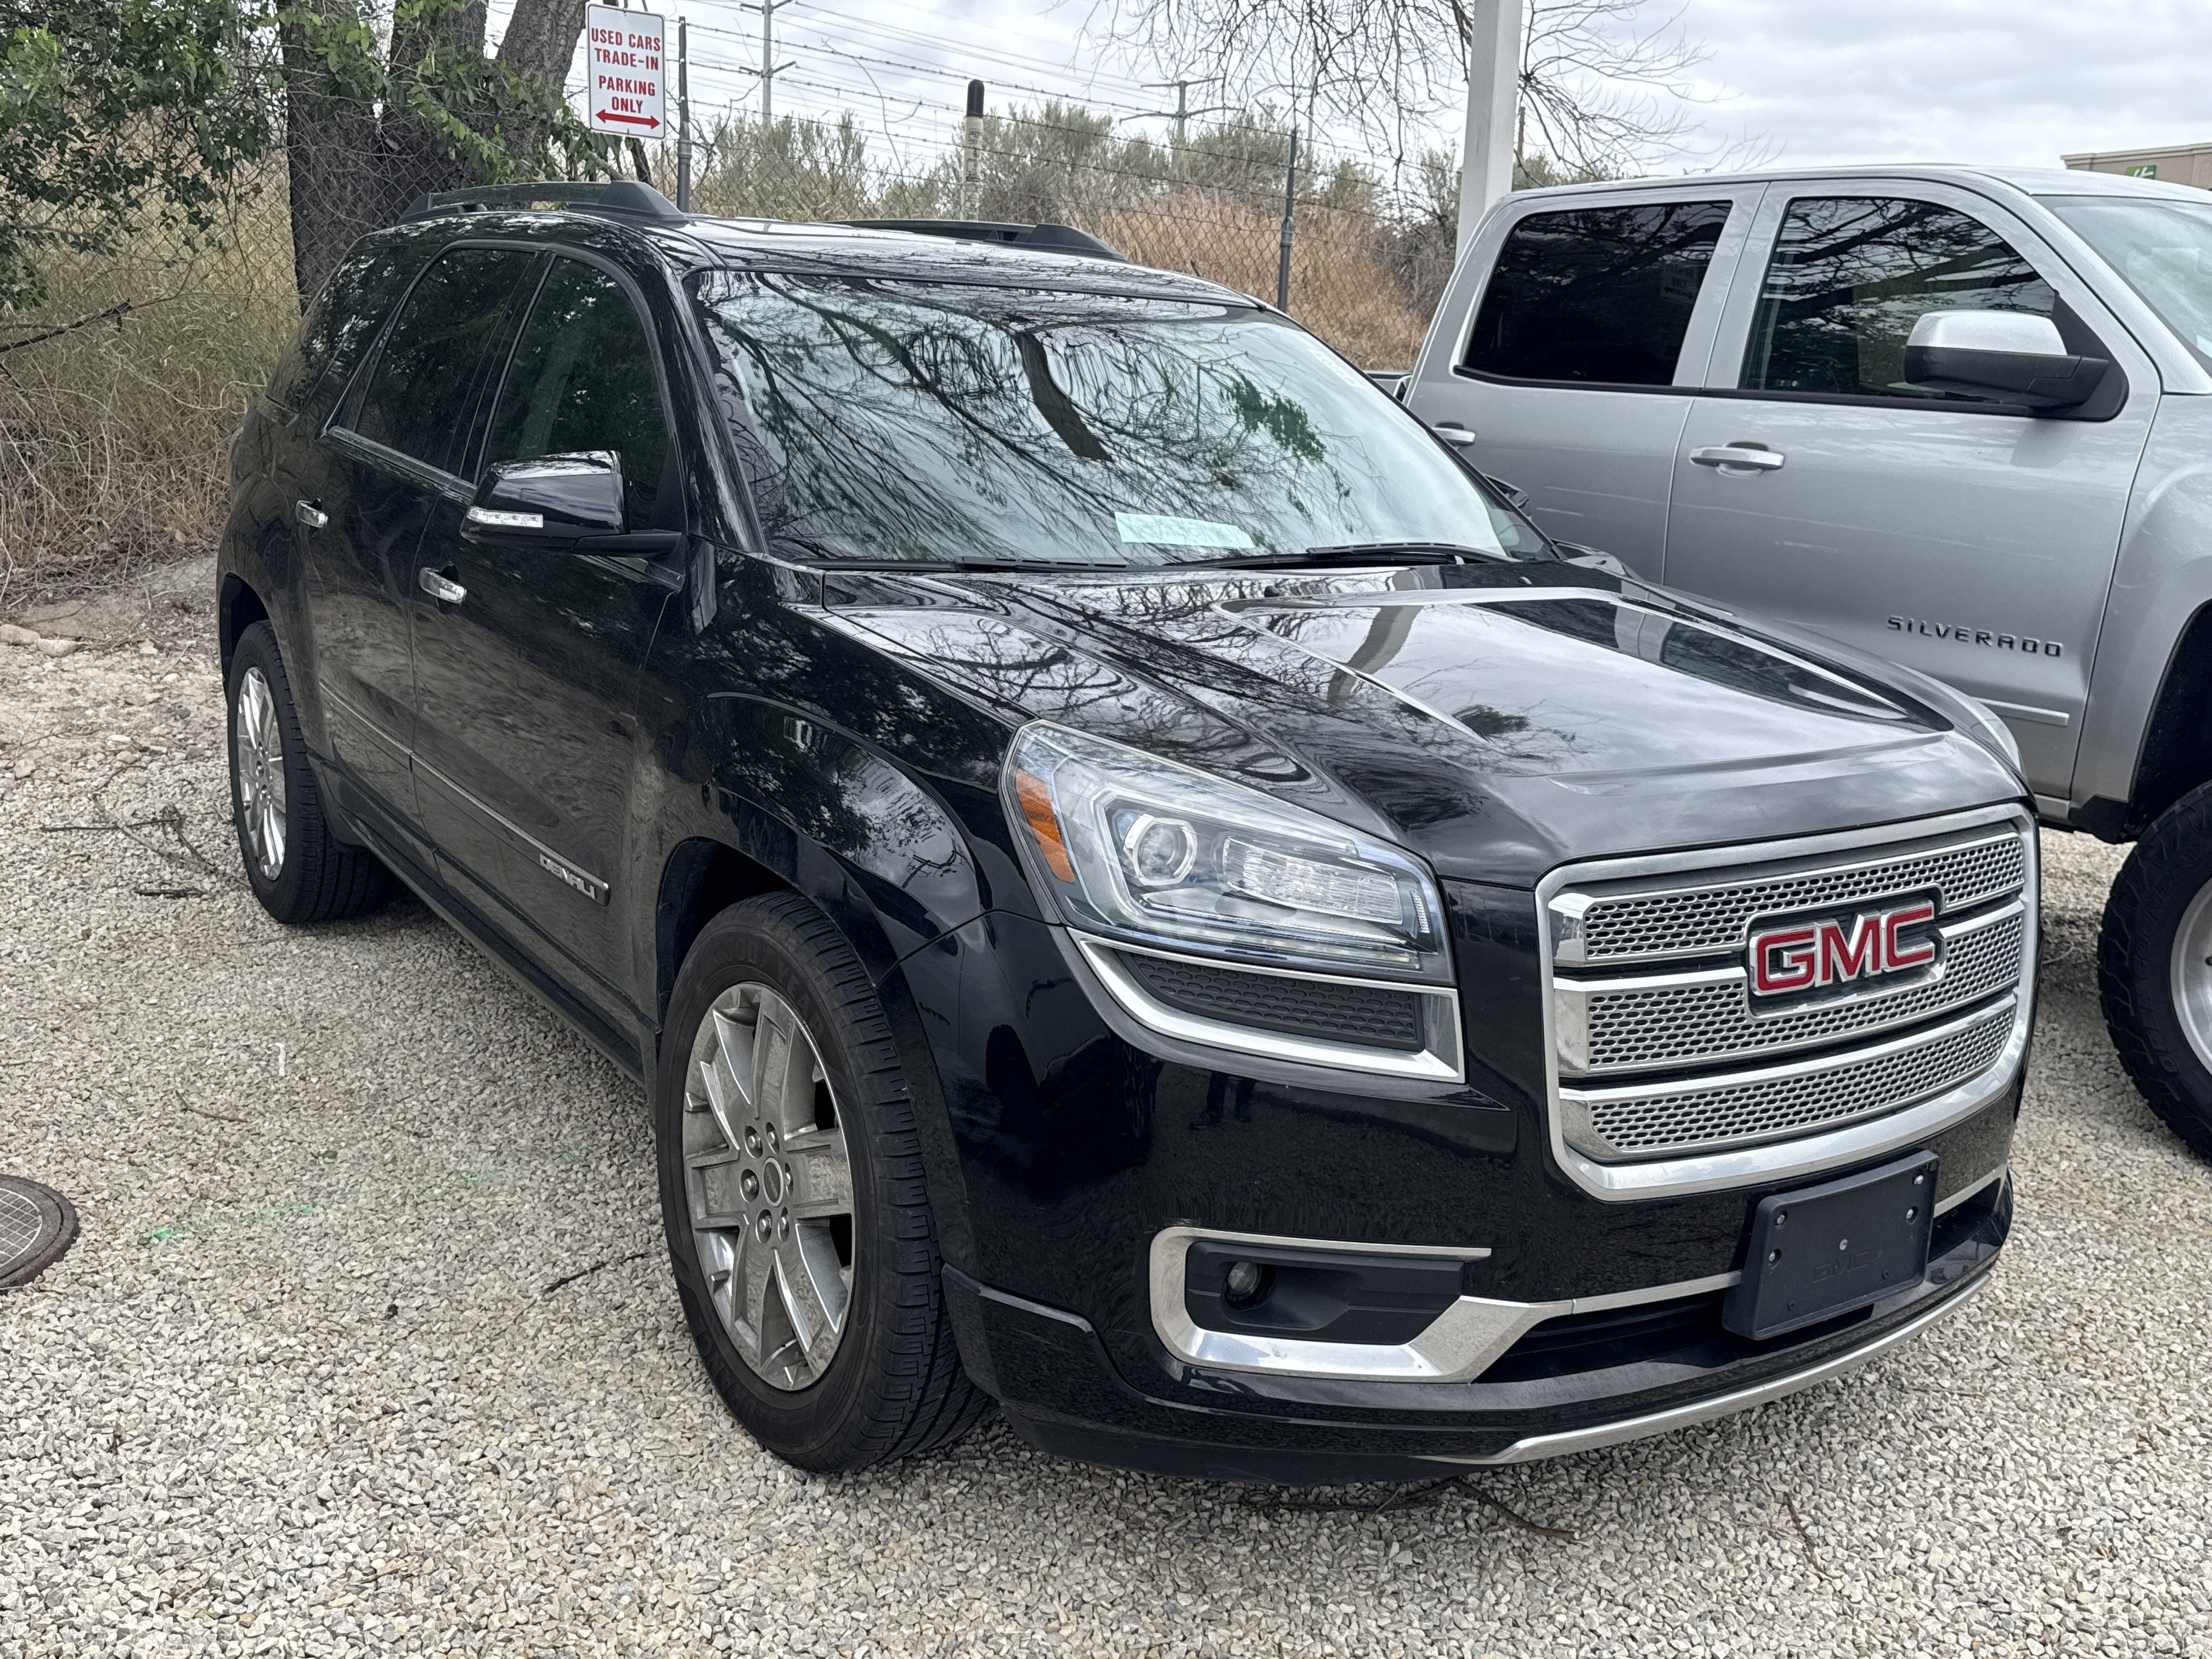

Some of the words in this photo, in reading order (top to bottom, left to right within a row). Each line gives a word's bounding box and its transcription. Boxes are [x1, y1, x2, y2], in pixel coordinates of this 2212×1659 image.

[591, 27, 622, 46] USED
[629, 33, 661, 52] CARS
[594, 48, 659, 71] TRADE-IN
[599, 75, 656, 97] PARKING
[612, 96, 644, 114] ONLY
[1887, 614, 2063, 658] SILVERADO
[1750, 900, 1935, 996] GMC
[1812, 1250, 1873, 1284] GMC
